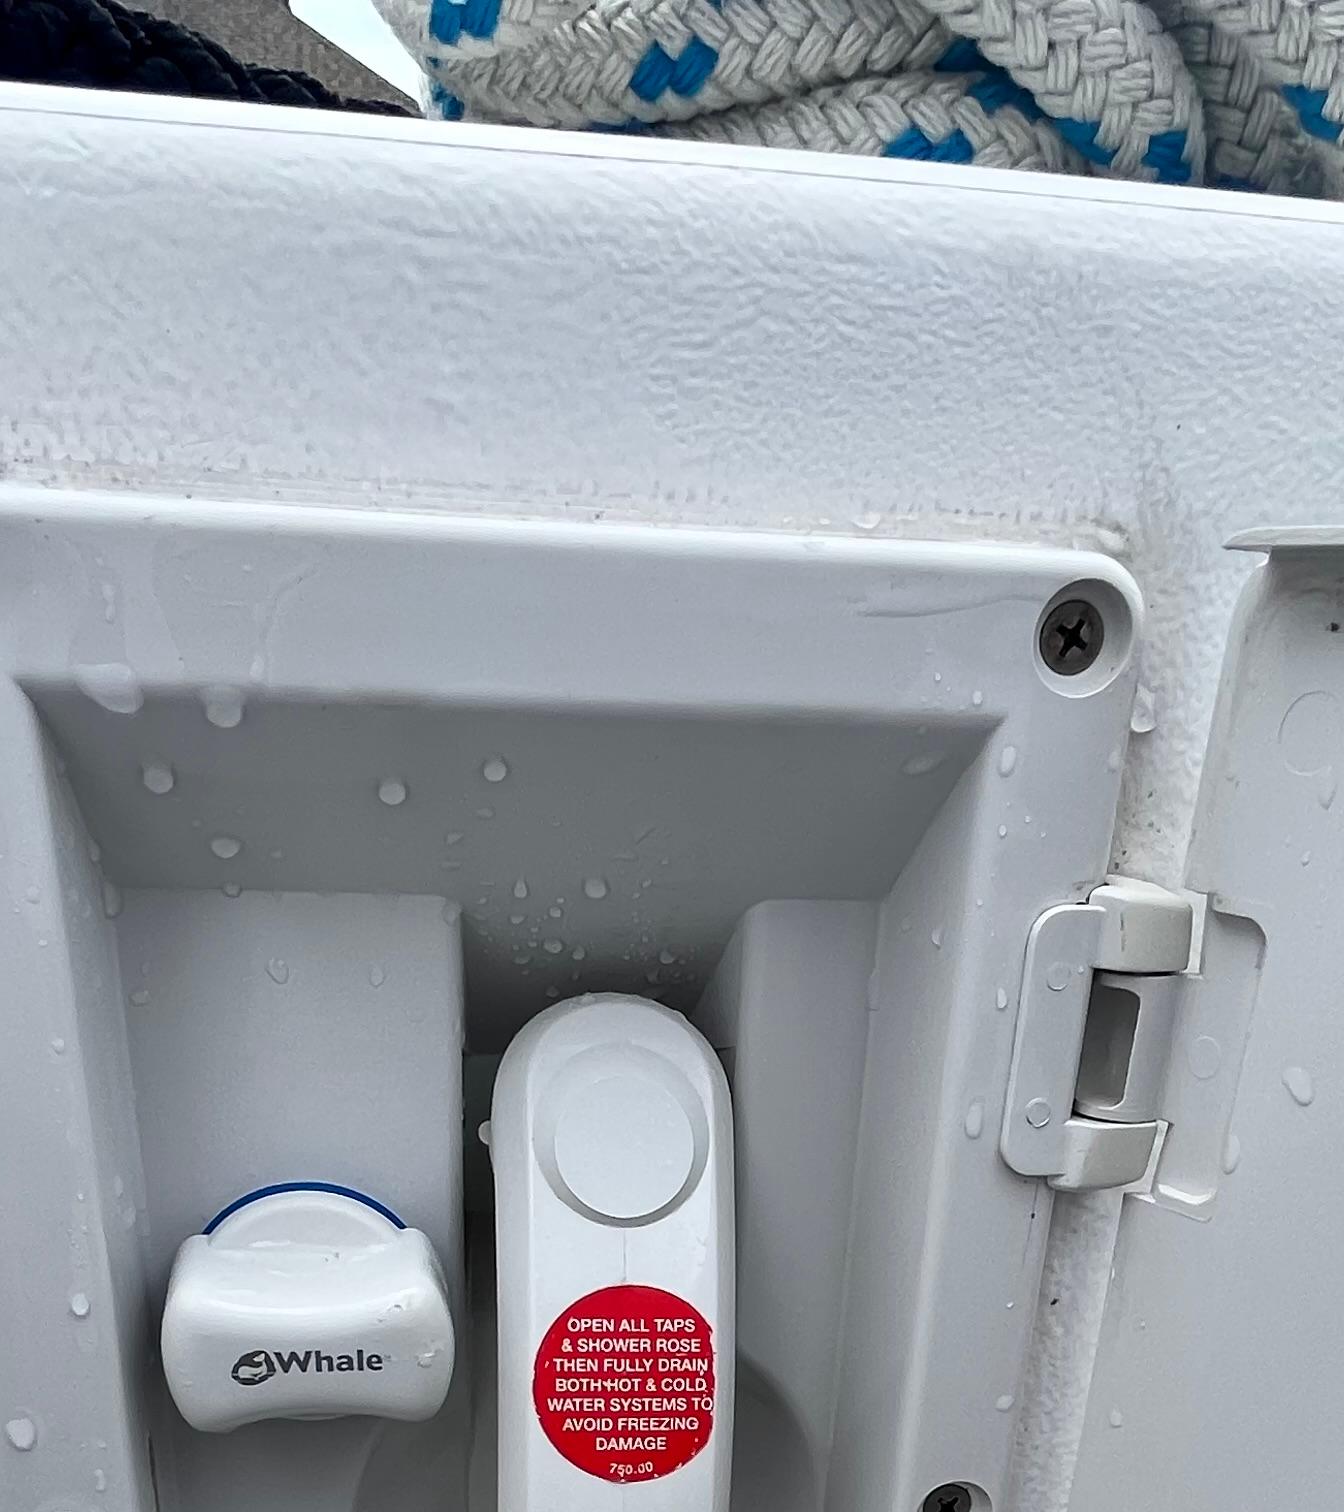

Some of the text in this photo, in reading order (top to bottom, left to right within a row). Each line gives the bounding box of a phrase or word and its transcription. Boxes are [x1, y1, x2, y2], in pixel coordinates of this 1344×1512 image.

[567, 1319, 695, 1332] OPEN ALL TAPS
[561, 1339, 701, 1352] & SHOWER ROSE
[273, 1350, 384, 1373] Whale
[553, 1358, 708, 1372] THEN FULLY DRAIN
[556, 1378, 706, 1391] BOTH HOT & COLD
[547, 1397, 713, 1411] WATER SYSTEMS TO
[562, 1417, 699, 1431] AVOID FREEZING
[596, 1437, 667, 1451] DAMAGE
